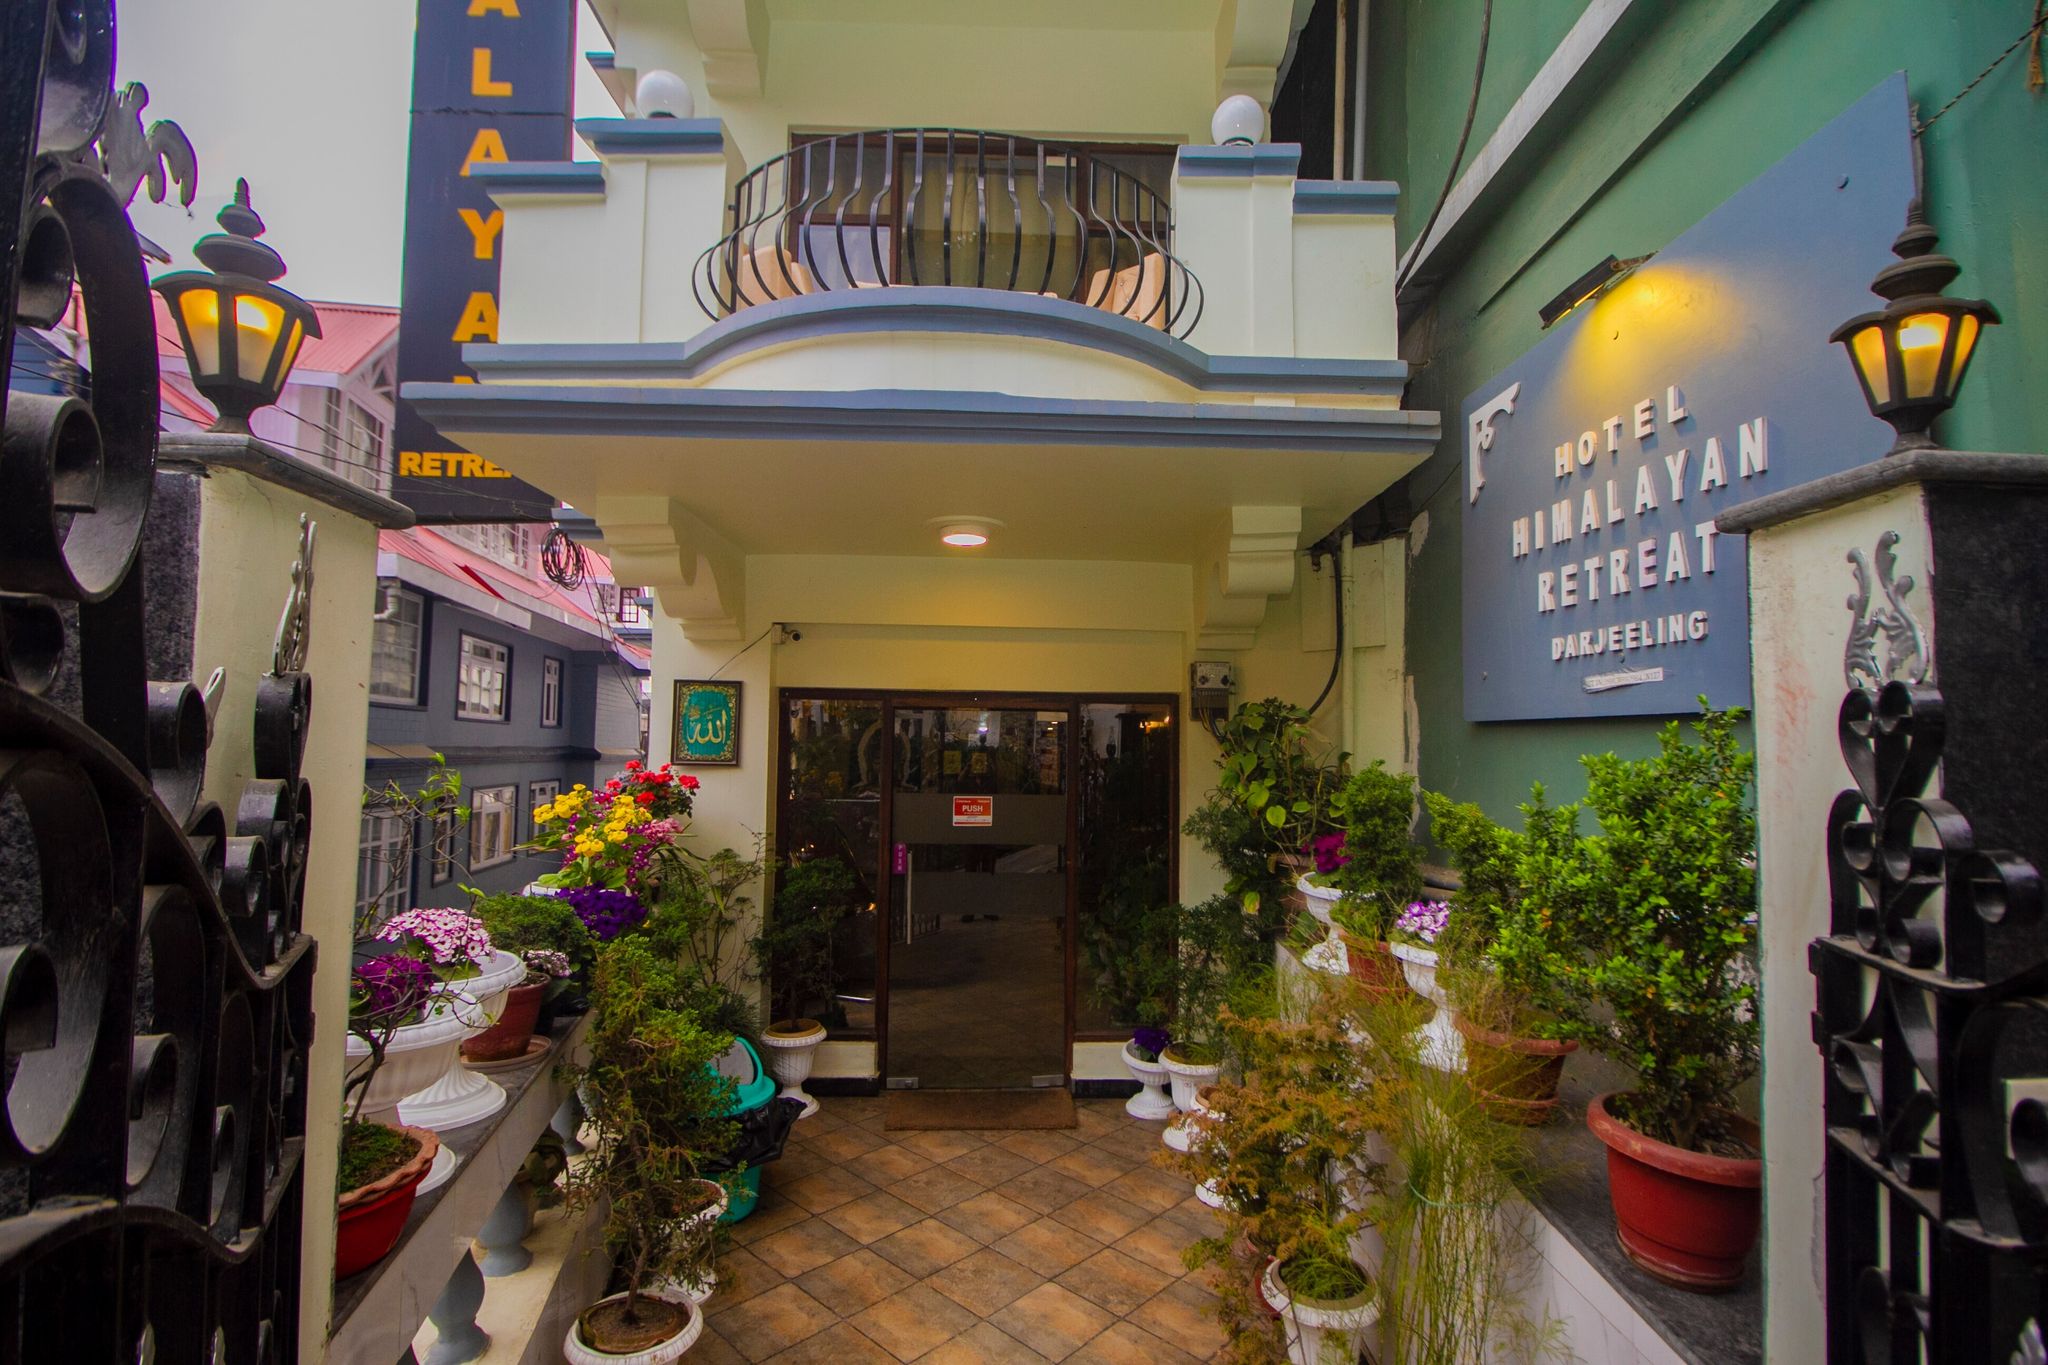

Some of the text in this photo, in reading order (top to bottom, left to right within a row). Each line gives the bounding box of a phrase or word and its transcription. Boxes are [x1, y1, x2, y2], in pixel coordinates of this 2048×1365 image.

[400, 452, 513, 478] RETRE
[1555, 384, 1689, 478] HOTEL
[1512, 415, 1768, 558] HIMALAYAN
[1537, 519, 1720, 612] RETREAT
[1552, 610, 1709, 661] DARJEELING
[962, 804, 983, 812] PUSH
